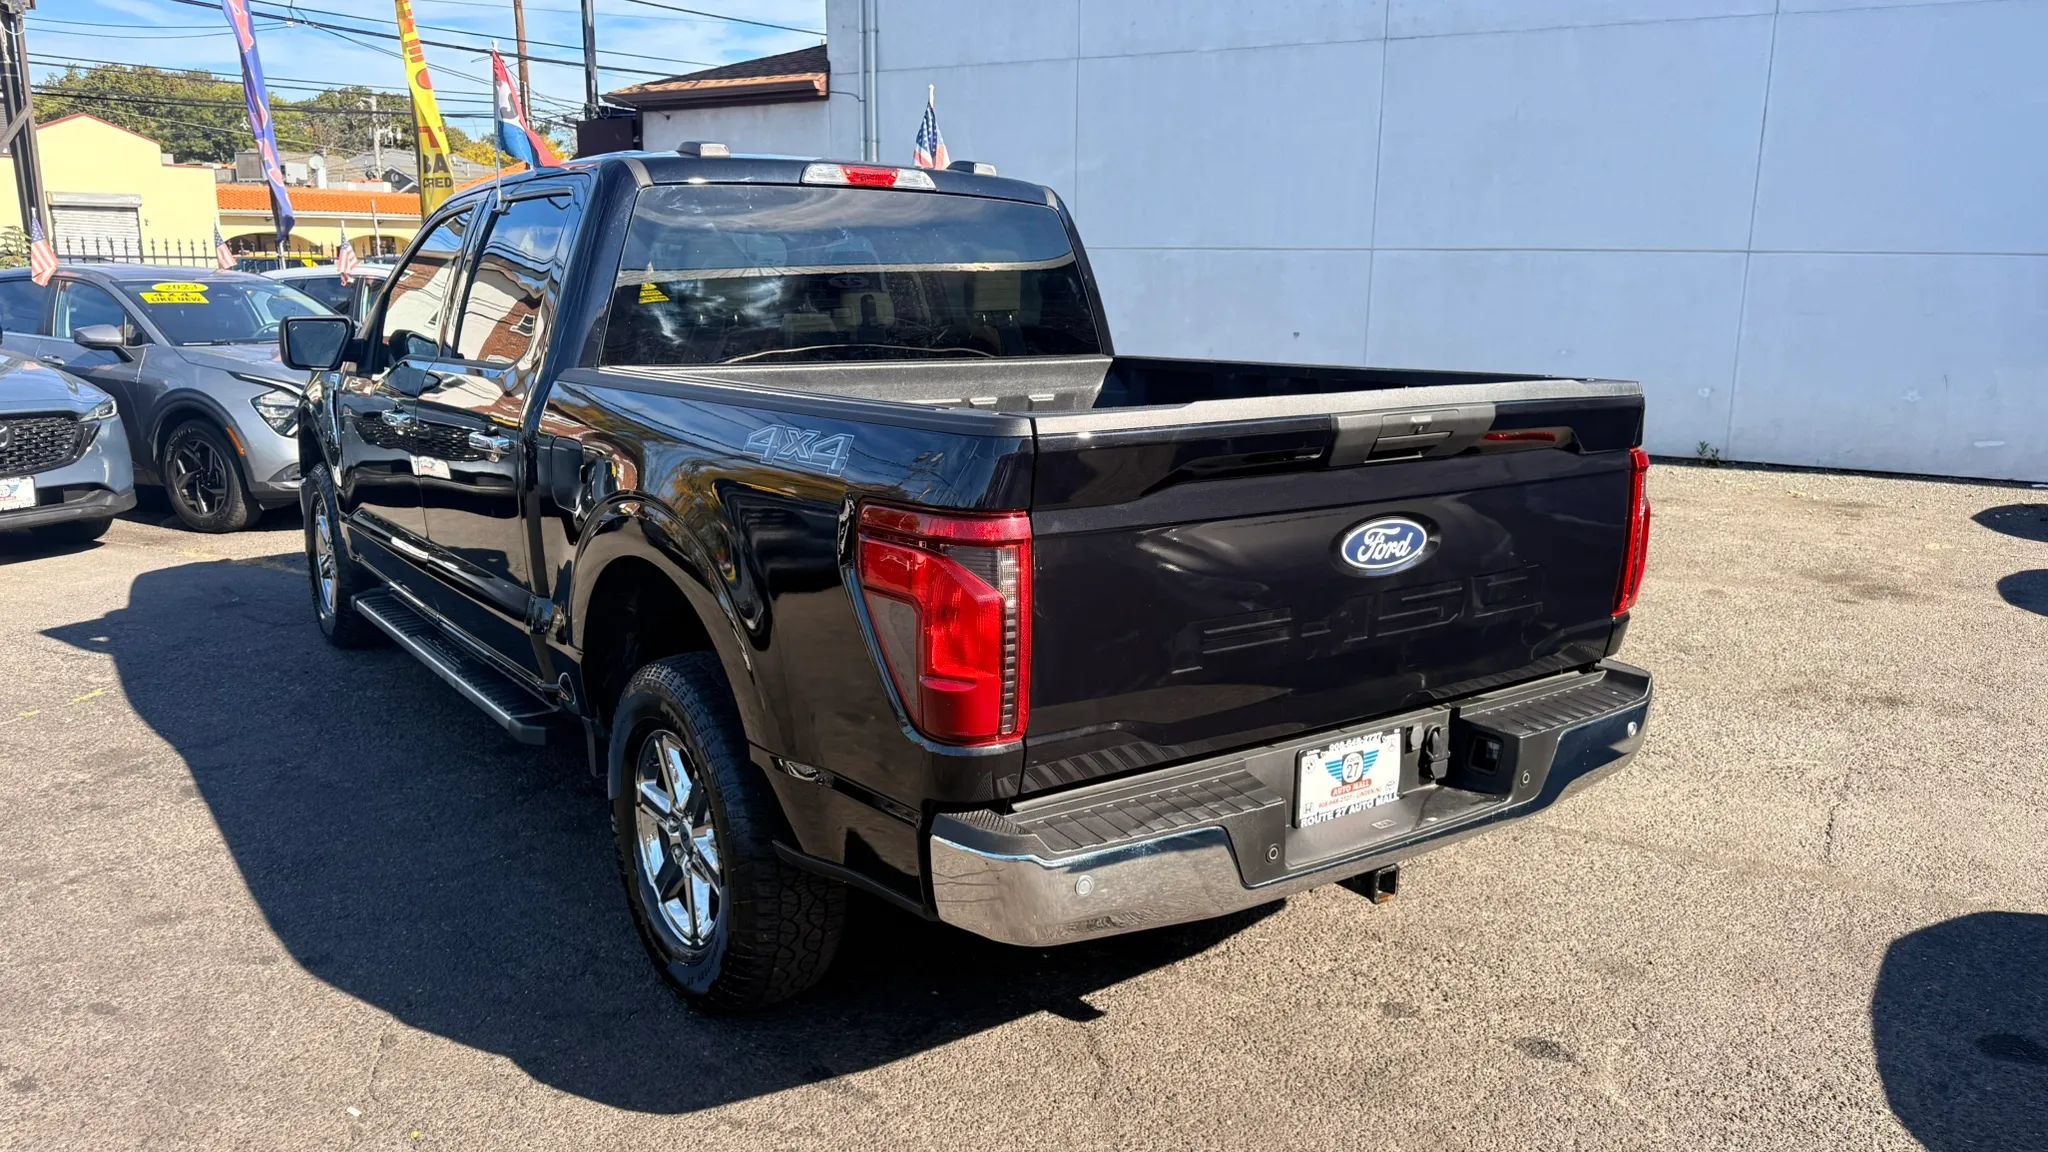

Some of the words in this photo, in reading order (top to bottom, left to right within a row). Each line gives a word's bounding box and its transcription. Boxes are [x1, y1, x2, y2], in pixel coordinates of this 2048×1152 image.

[743, 424, 854, 477] 4X4
[1357, 526, 1414, 562] Ford
[1333, 784, 1351, 797] AUTO
[1352, 779, 1370, 791] MALL
[1346, 762, 1360, 779] 27
[1300, 808, 1335, 828] ROUTE
[1335, 806, 1347, 819] 27
[1349, 799, 1374, 816] AUTO
[1375, 792, 1400, 806] MALL
